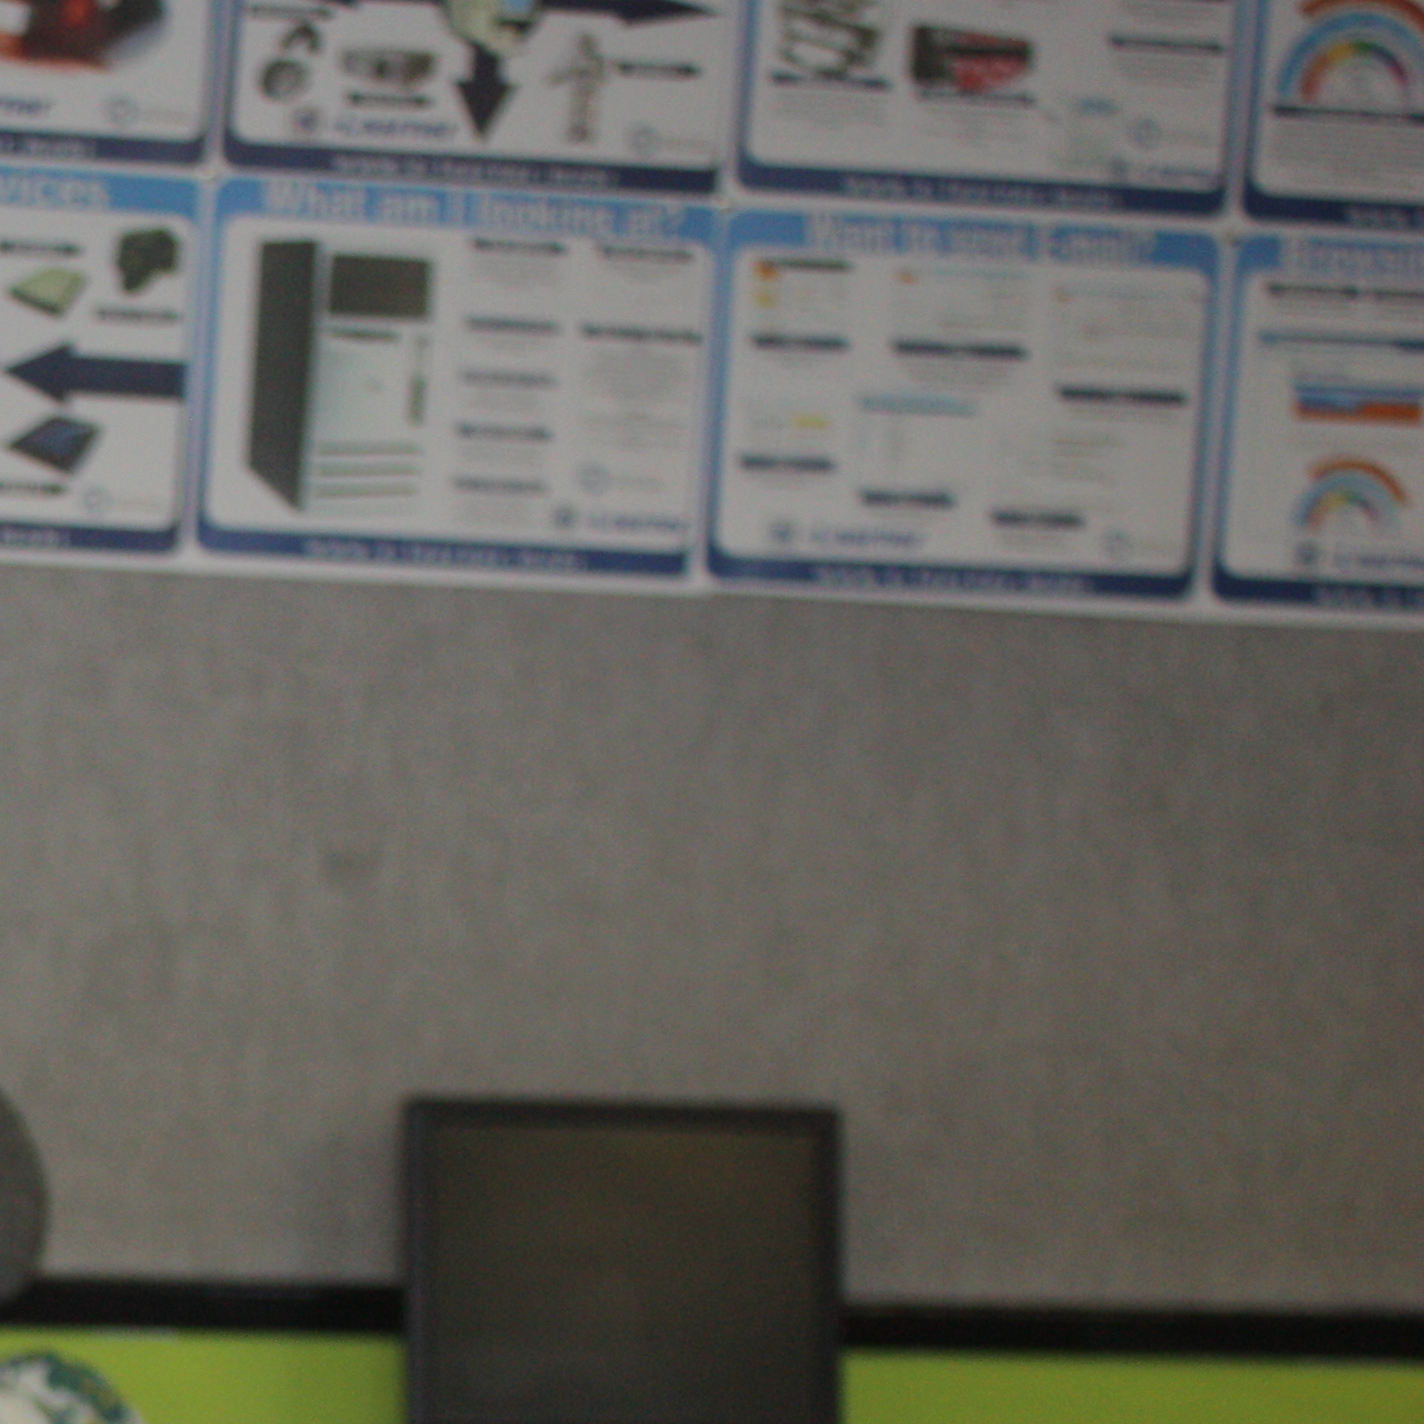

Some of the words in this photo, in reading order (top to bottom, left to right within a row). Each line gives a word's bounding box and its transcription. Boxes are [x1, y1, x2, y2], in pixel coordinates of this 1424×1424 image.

[264, 180, 374, 219] What
[382, 192, 441, 223] am
[474, 193, 616, 236] looking
